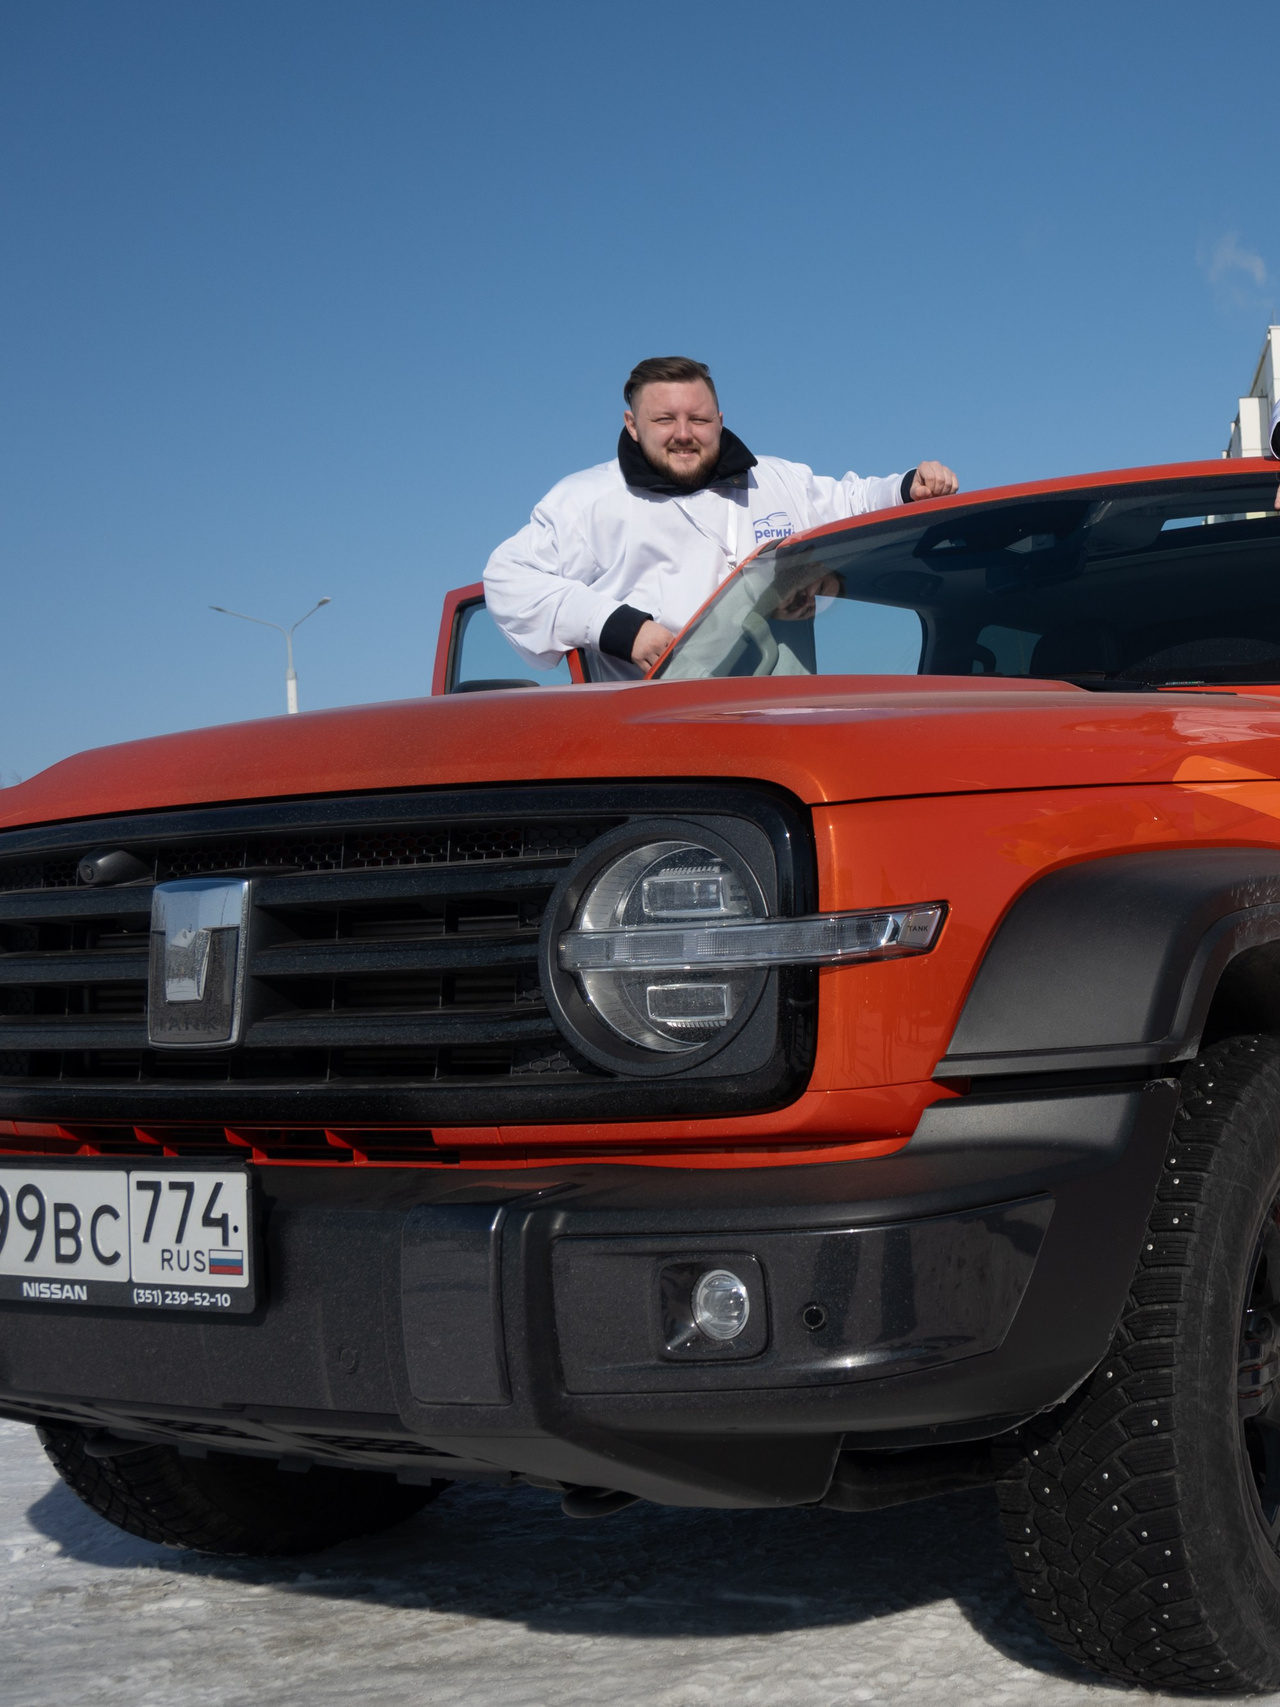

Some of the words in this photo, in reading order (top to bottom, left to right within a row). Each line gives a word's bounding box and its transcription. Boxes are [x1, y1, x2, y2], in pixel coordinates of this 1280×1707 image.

[754, 527, 792, 544] регин
[160, 1248, 207, 1272] RUS
[22, 1281, 88, 1301] NISSAN
[132, 1287, 163, 1306] (351)
[164, 1289, 232, 1308] 239-52-10
